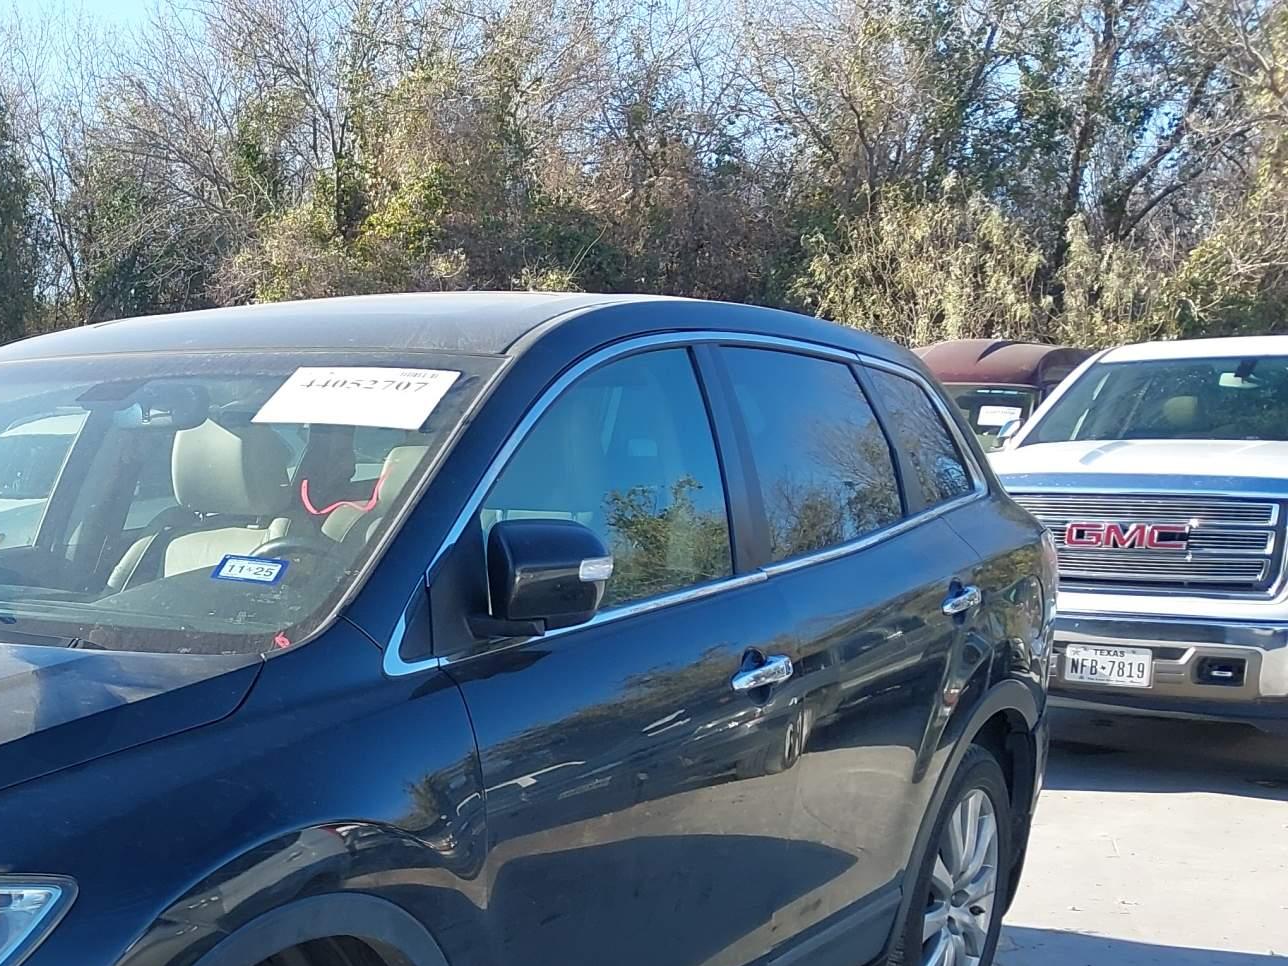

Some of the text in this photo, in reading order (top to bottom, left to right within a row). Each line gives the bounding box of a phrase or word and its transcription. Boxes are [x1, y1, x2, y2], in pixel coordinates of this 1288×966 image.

[299, 378, 430, 393] 44052707
[1064, 522, 1190, 550] GMC
[1093, 648, 1126, 658] TEXAS
